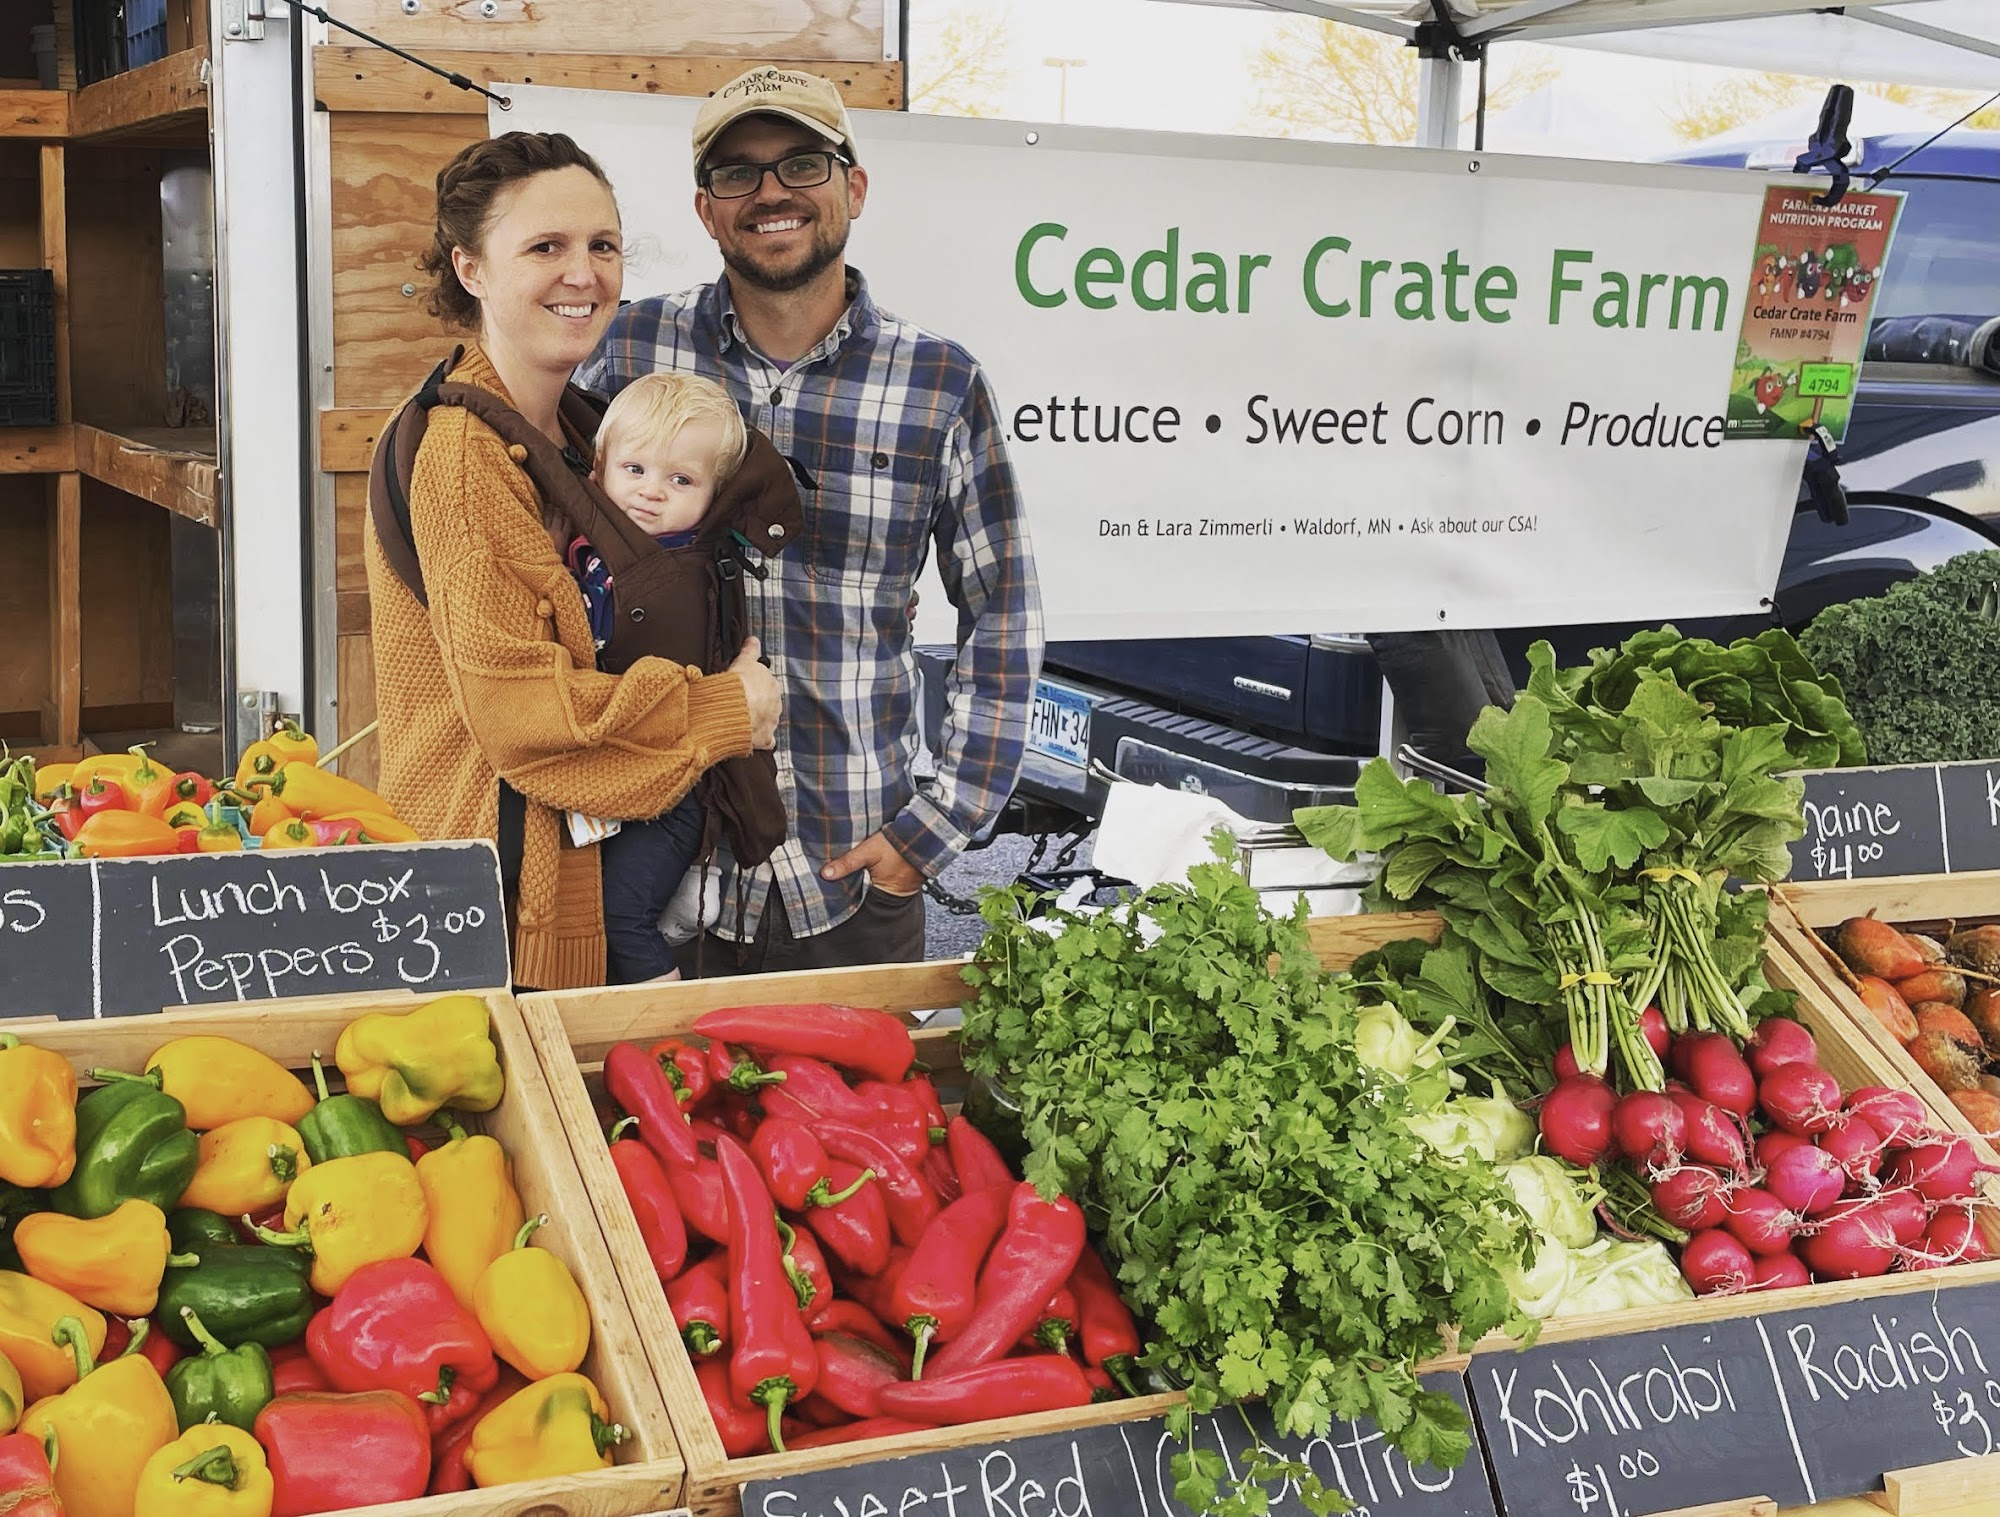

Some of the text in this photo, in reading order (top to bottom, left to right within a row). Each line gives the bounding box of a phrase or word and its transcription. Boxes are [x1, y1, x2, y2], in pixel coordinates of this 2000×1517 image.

[745, 83, 782, 96] FARM
[766, 70, 808, 88] CRATE
[1769, 213, 1883, 231] NUTRITION PROGRAM
[1831, 203, 1878, 216] MARKET
[1015, 222, 1729, 332] Cedar Crate Farm
[1753, 305, 1857, 324] Cedar Crate Farm
[1770, 327, 1830, 341] FMNP #4794
[1808, 379, 1840, 393] 4794
[1006, 394, 1725, 448] ettuce Sweet Corn Produce
[1100, 515, 1537, 537] Dan & Lara Zimmerli Waldorf, MN Ask about our CSA!
[1031, 698, 1061, 740] FHN
[152, 868, 413, 927] Lunch box
[159, 933, 373, 1004] Peppers
[1788, 1305, 1989, 1401] Radish
[1492, 1335, 1736, 1457] Kohlrabi
[978, 1441, 1094, 1517] Red
